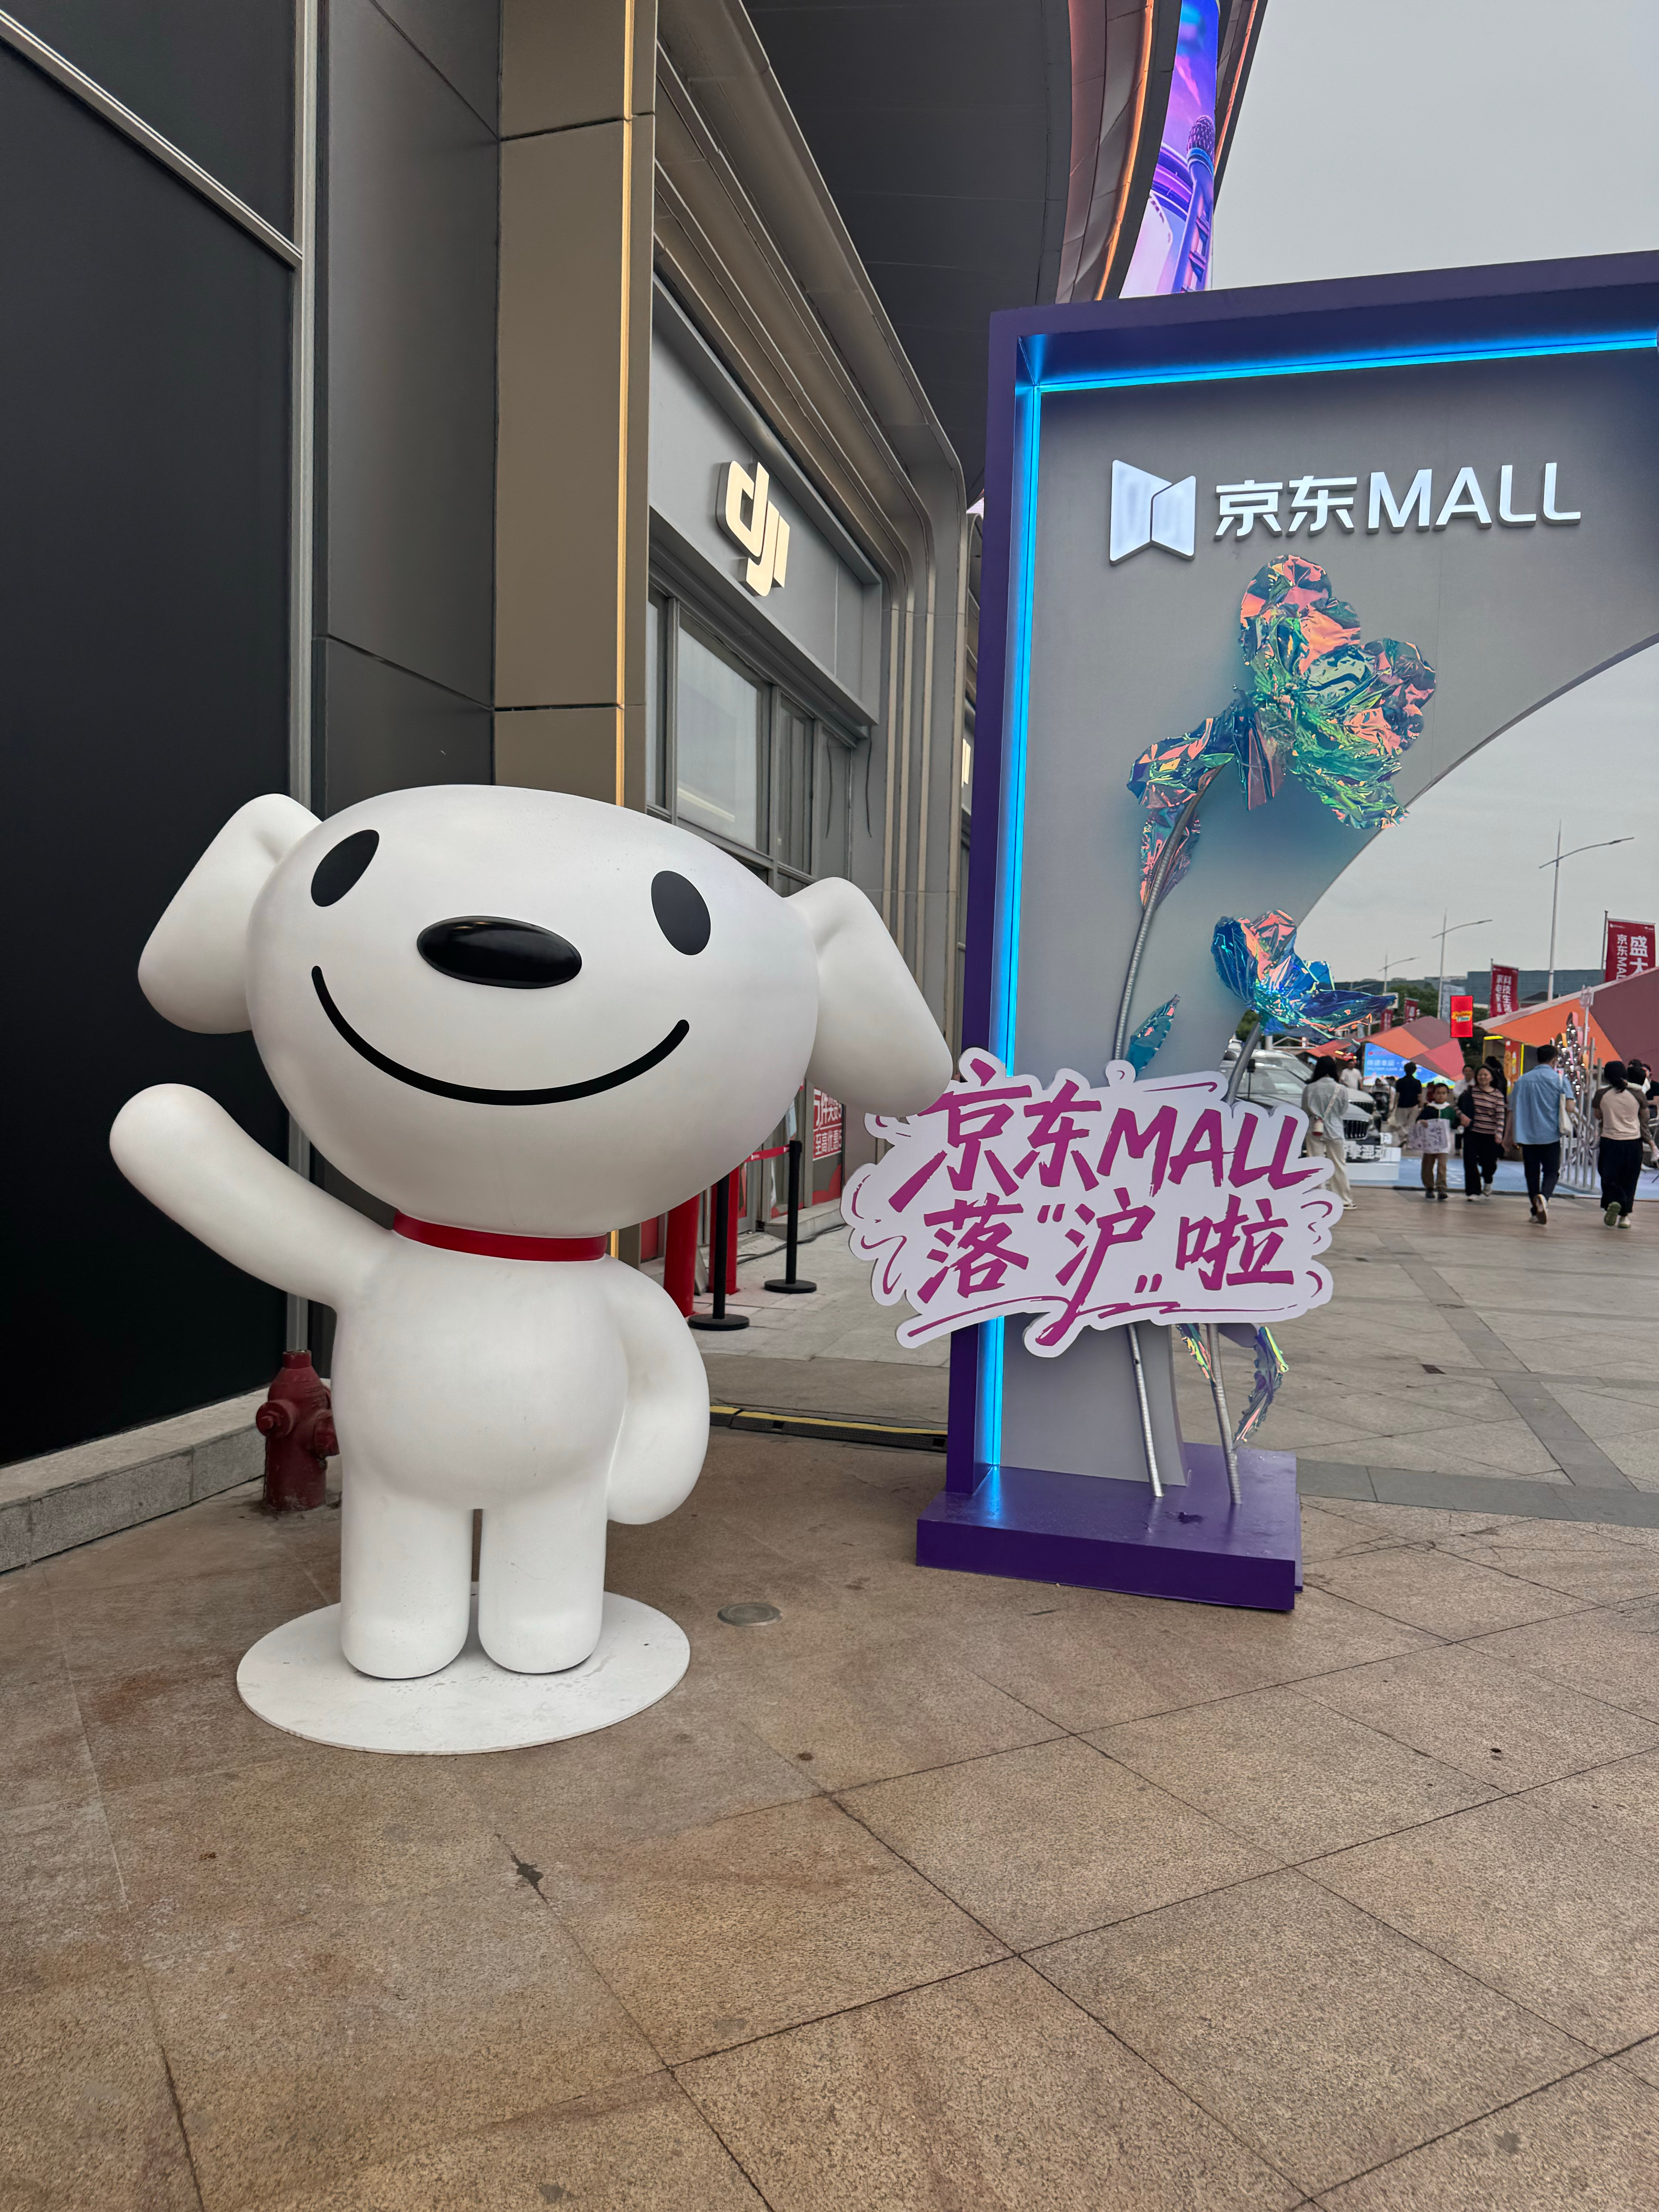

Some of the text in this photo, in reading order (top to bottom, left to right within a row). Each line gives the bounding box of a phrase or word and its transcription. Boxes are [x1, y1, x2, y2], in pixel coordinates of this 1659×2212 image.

[1213, 462, 1581, 541] 京东MALL
[1629, 935, 1649, 975] 盛大
[888, 1057, 1324, 1212] 京东MALL
